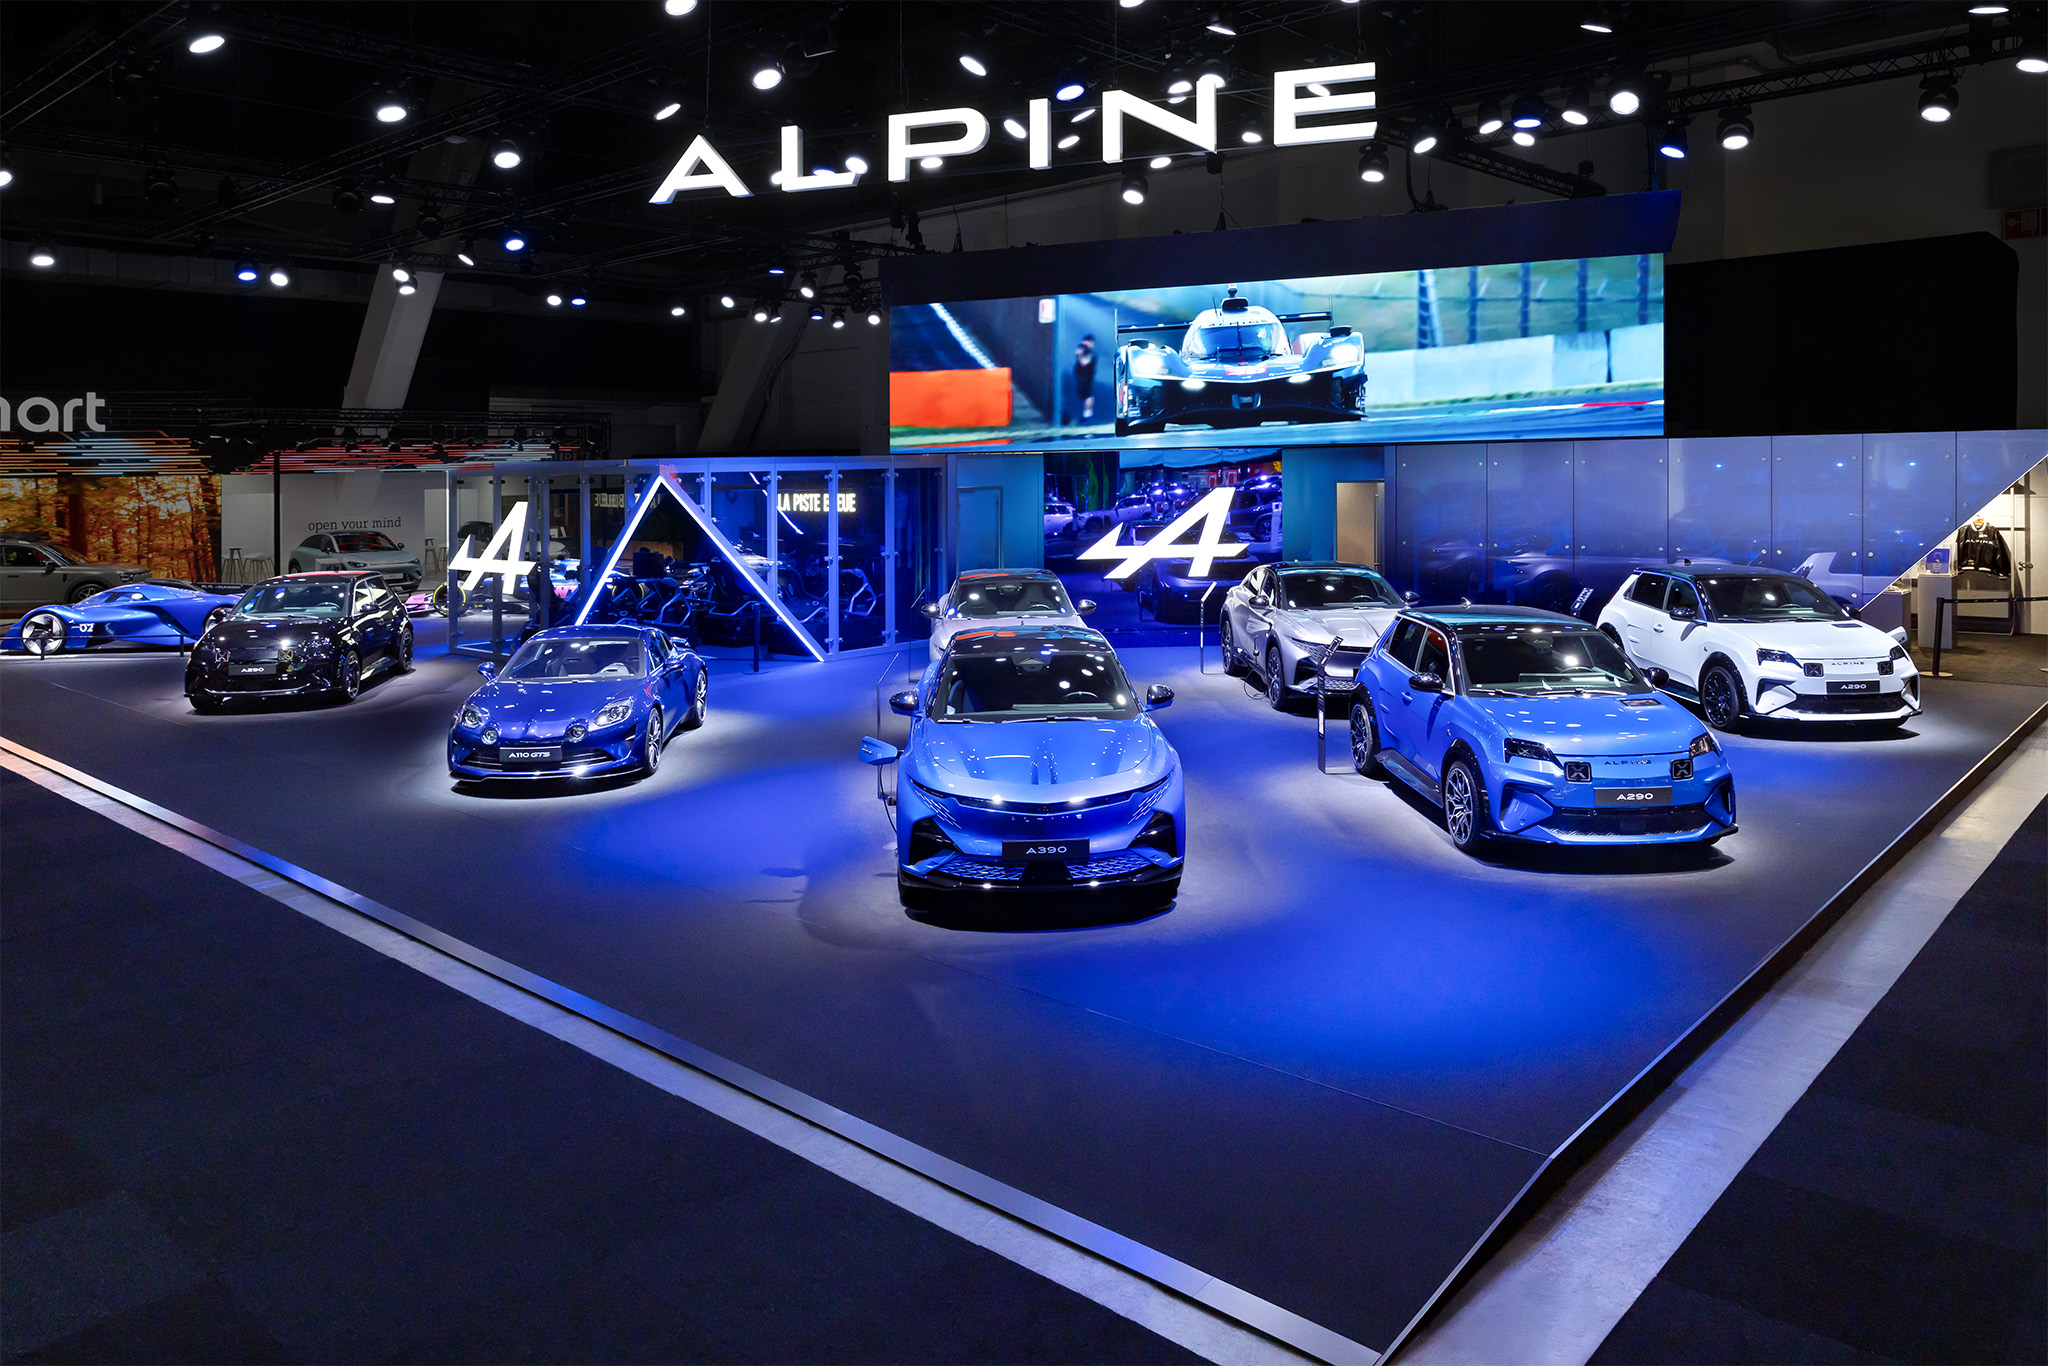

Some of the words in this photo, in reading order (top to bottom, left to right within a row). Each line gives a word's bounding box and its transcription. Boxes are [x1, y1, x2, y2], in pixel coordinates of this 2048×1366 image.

[649, 62, 1378, 205] ALPINE
[0, 392, 106, 432] art
[777, 493, 791, 512] LA
[793, 493, 821, 512] PISTE
[823, 493, 856, 512] BEUE
[307, 521, 338, 533] open
[340, 520, 369, 530] your
[372, 517, 402, 528] mind
[1616, 792, 1654, 801] A290
[1026, 845, 1067, 855] A390
